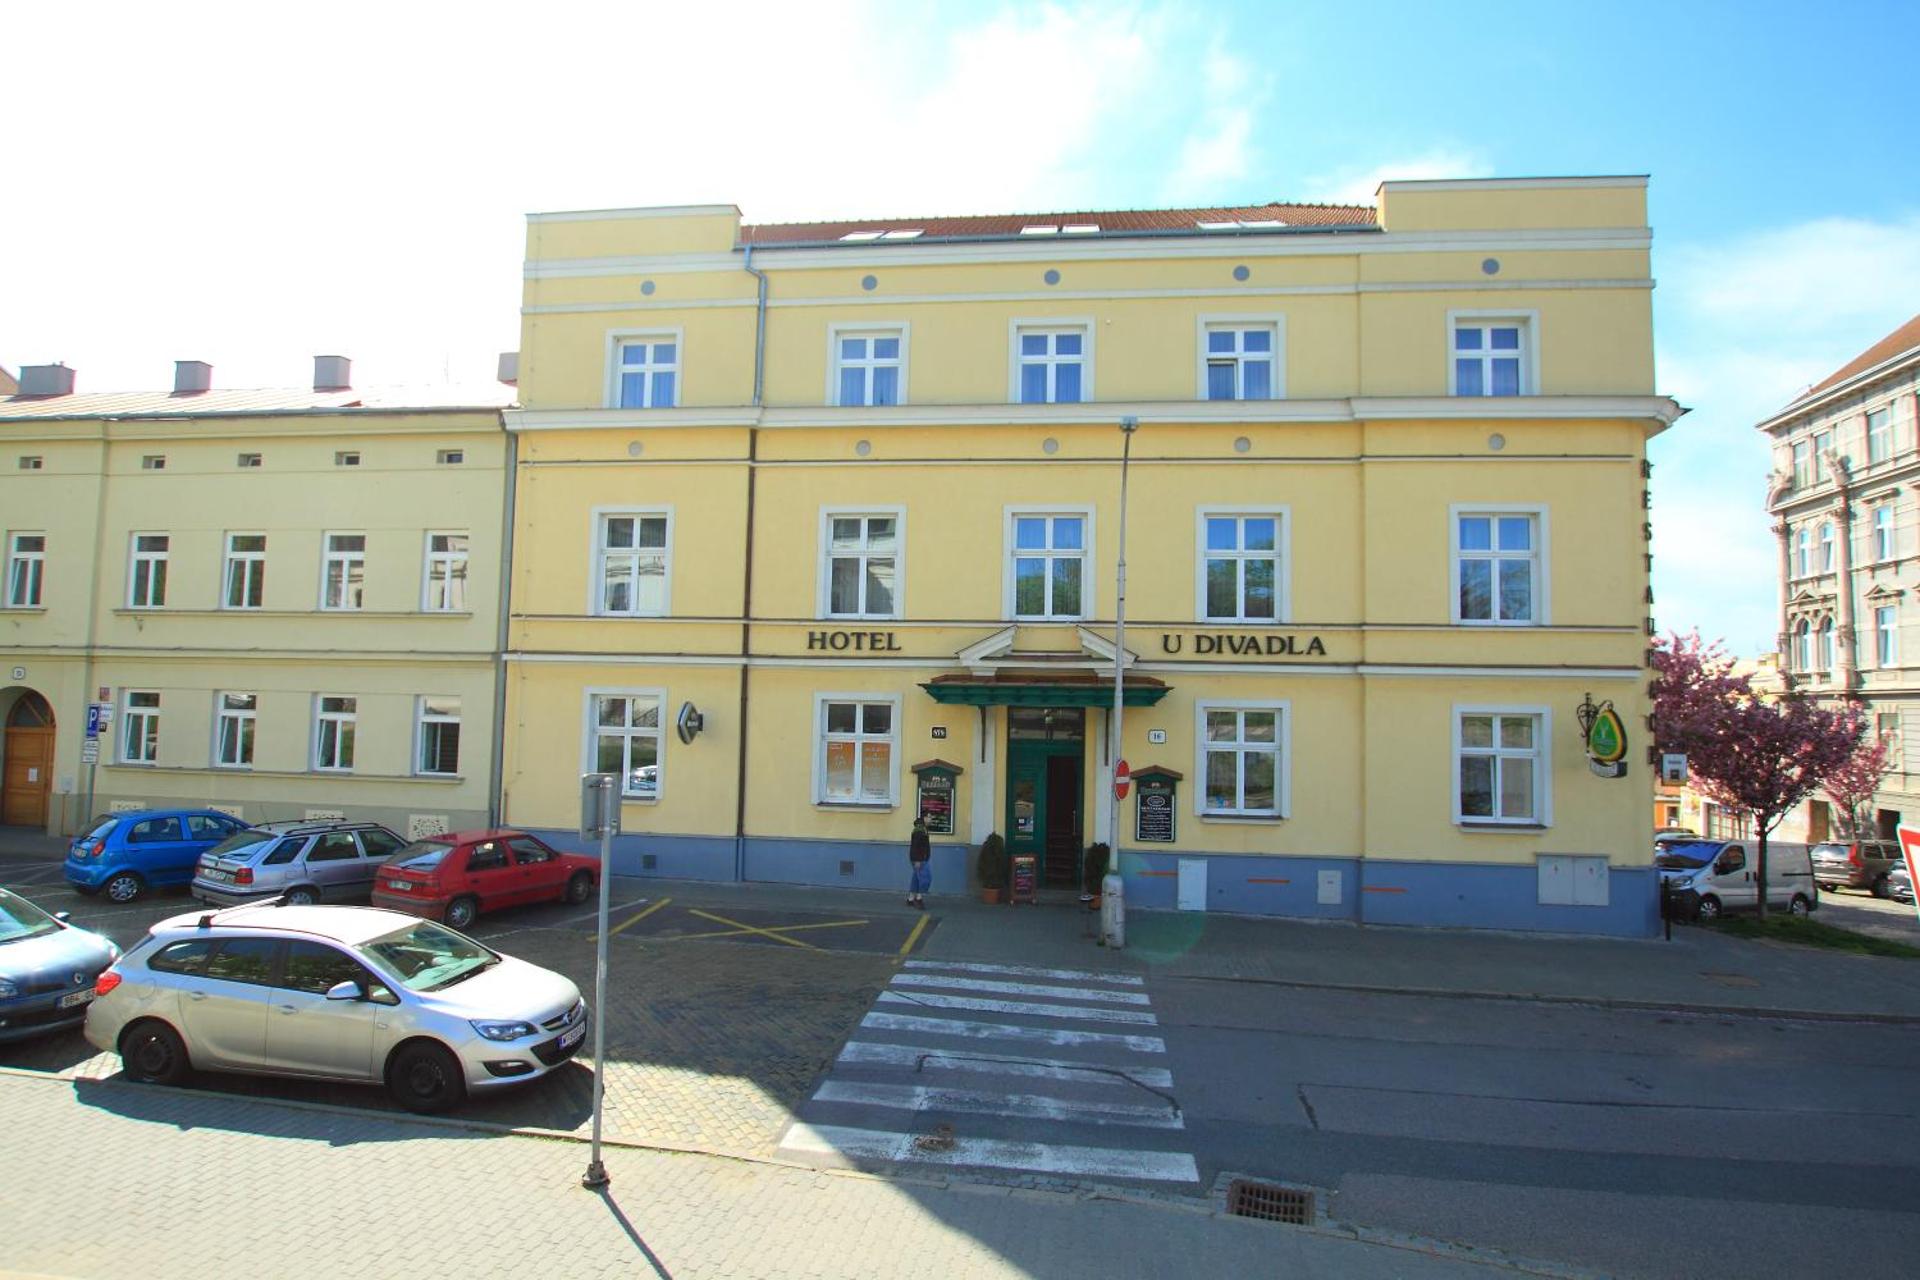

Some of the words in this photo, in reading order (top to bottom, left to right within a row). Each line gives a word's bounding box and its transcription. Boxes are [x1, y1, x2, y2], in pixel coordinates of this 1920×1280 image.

[807, 631, 902, 651] HOTEL
[1162, 634, 1182, 654] U
[1195, 634, 1327, 656] DIVADLA
[89, 708, 98, 728] P
